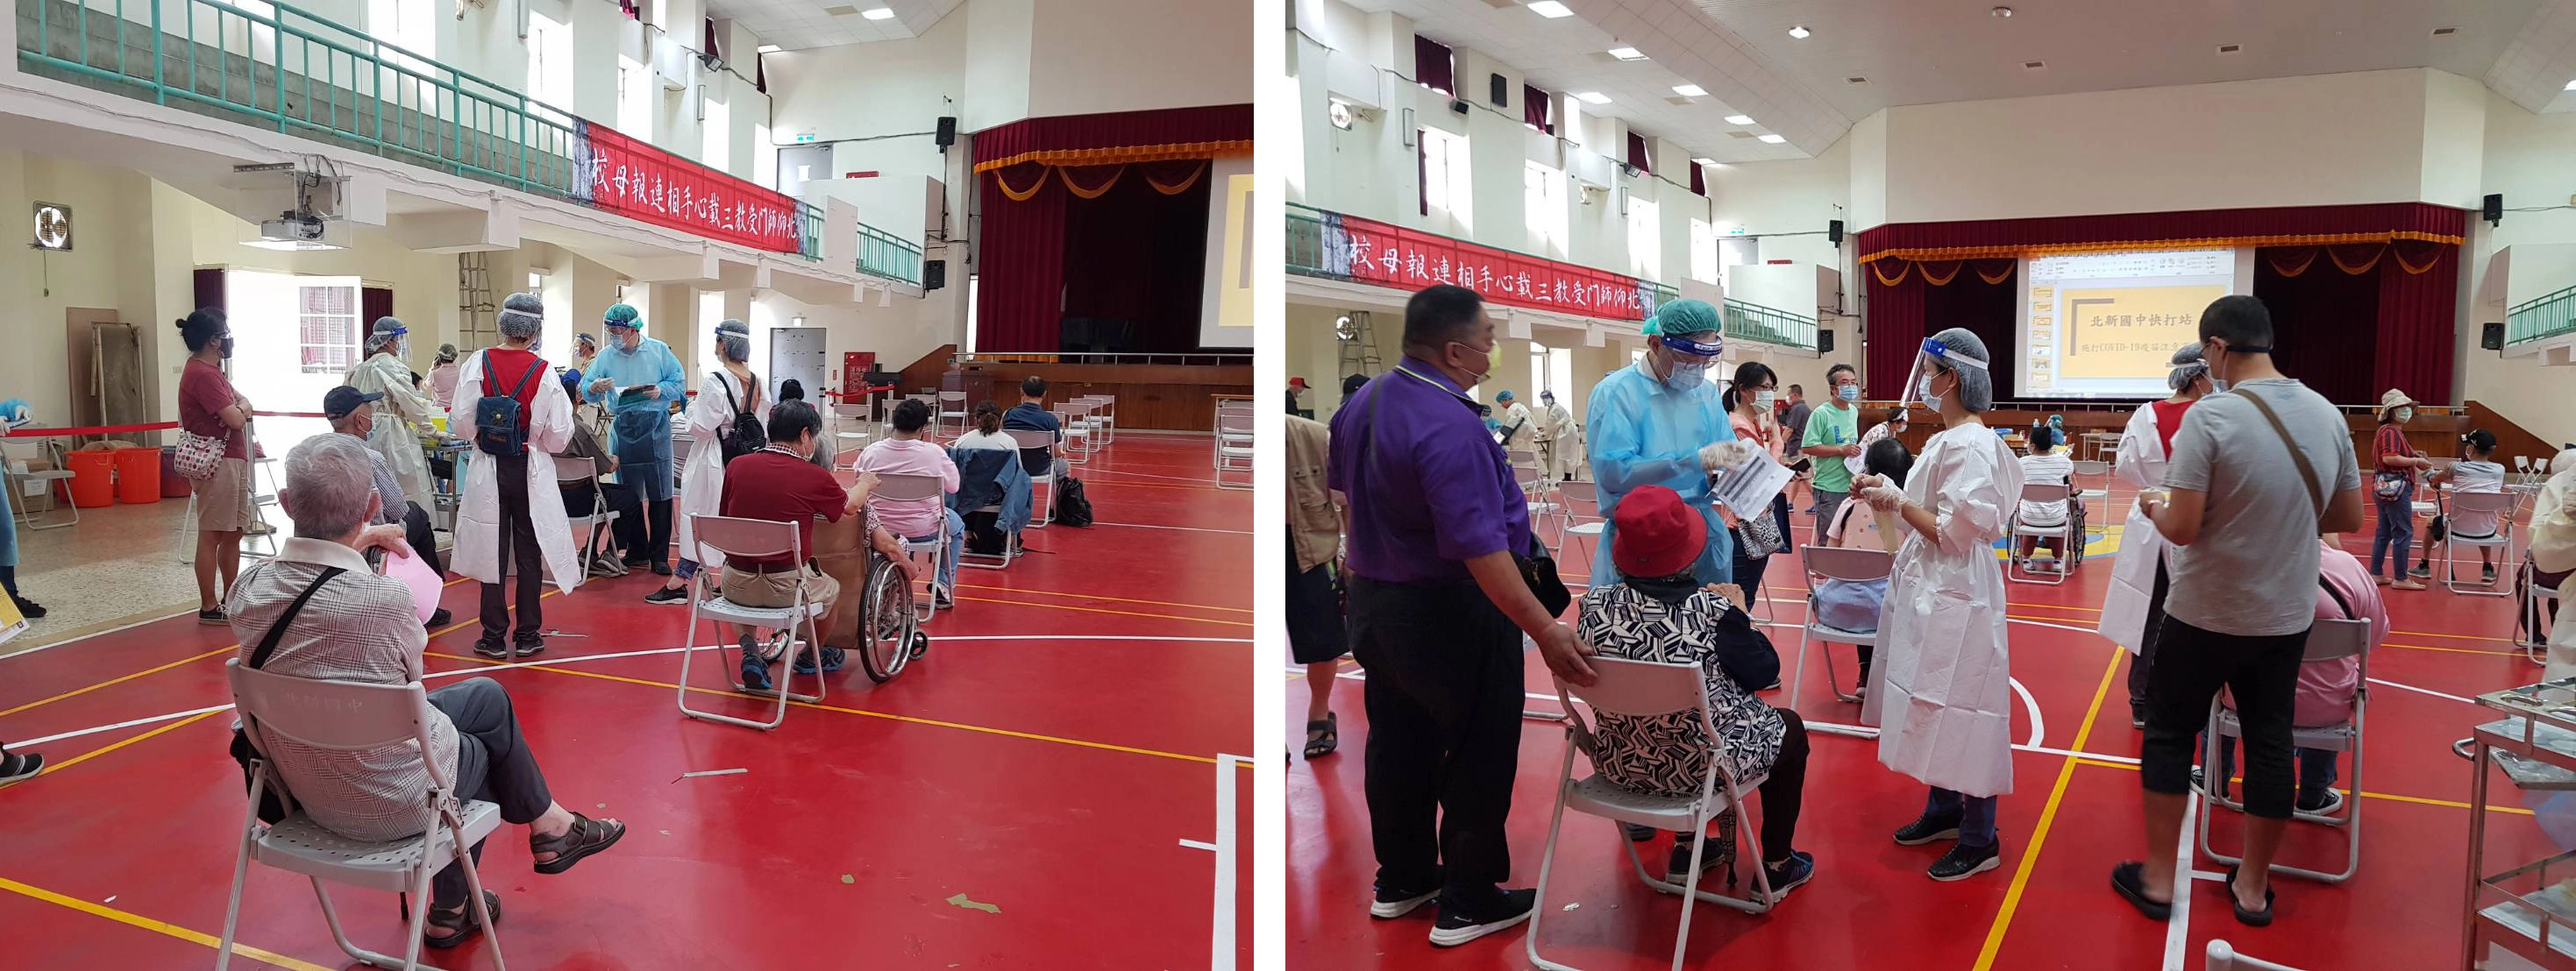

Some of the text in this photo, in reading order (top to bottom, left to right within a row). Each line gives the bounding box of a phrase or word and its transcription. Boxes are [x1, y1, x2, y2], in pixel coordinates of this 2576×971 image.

[2090, 314, 2192, 327] 北新國中快打站
